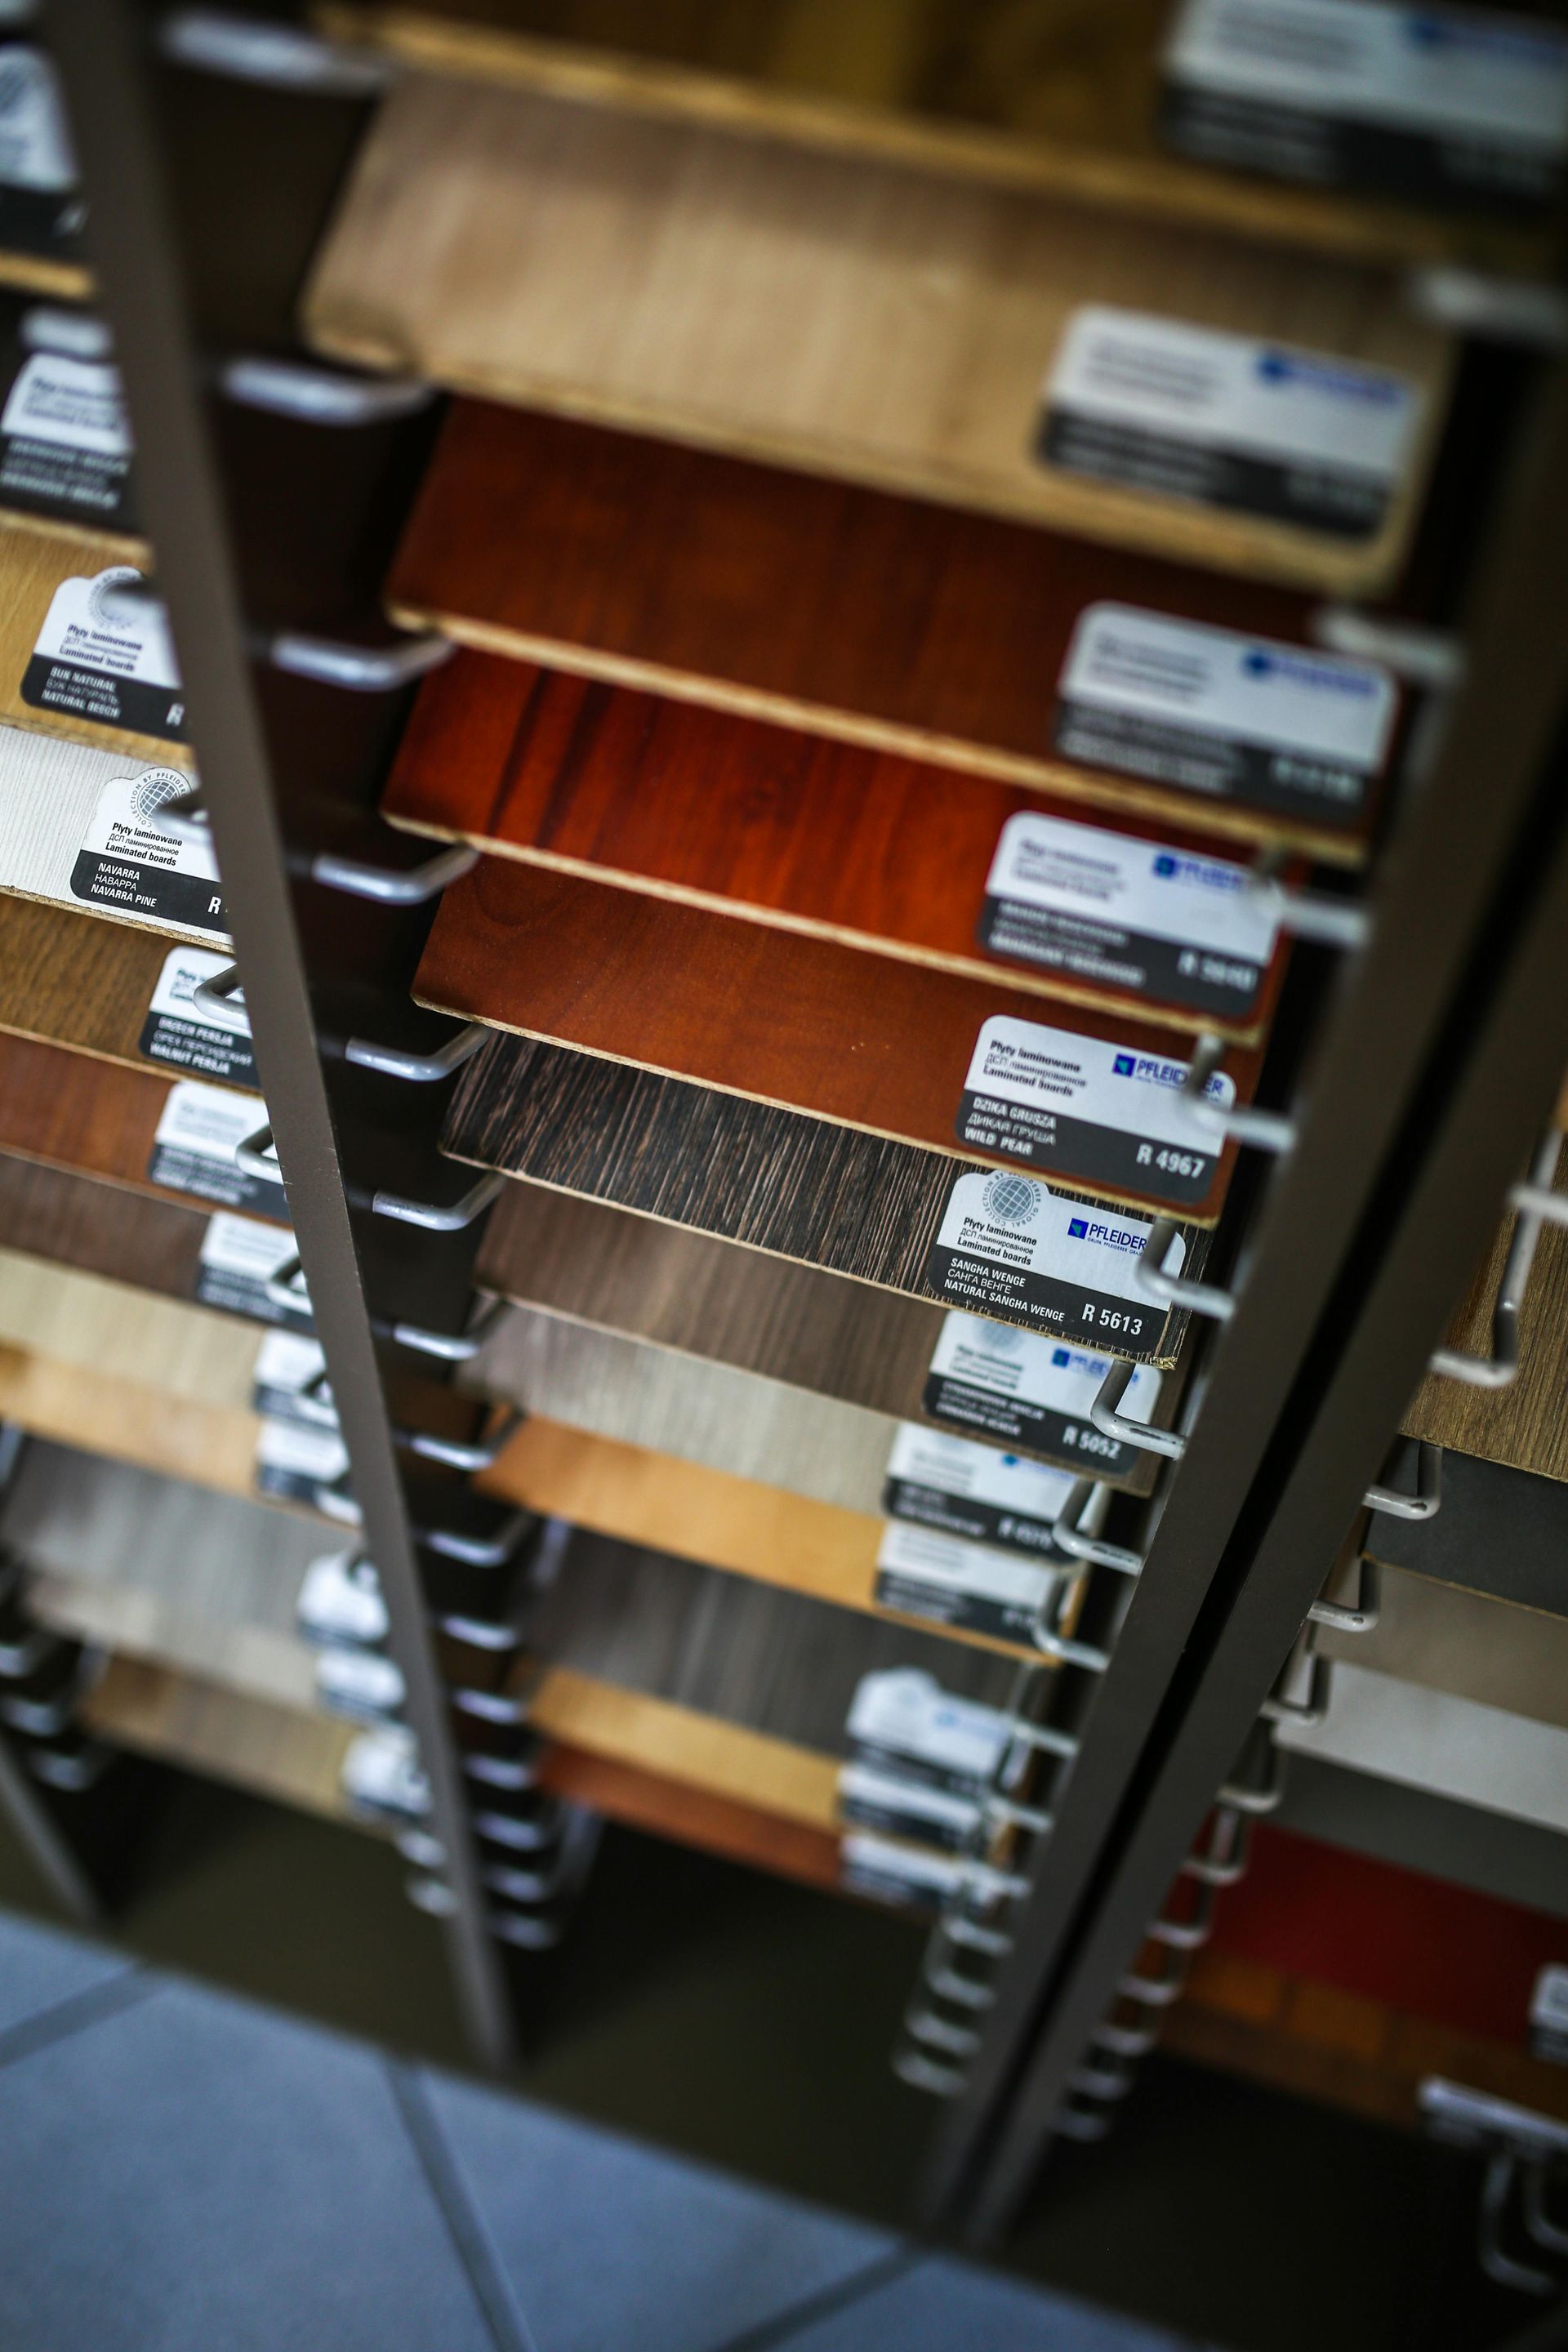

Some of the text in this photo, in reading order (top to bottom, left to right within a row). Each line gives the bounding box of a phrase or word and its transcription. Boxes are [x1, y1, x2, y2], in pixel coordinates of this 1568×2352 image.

[71, 672, 116, 693] NATURAL
[41, 689, 87, 710] NATURAL
[108, 833, 125, 843] ДСП
[133, 827, 183, 847] laminowane
[105, 841, 177, 866] Laminated boards
[98, 862, 140, 881] NAVARRA
[90, 884, 158, 907] NAVARRA PINE
[207, 896, 221, 915] R
[1136, 1059, 1223, 1095] PFLEIDER
[1009, 1106, 1057, 1130] GRUSZA
[964, 1125, 1033, 1156] WILD PEAR
[1136, 1143, 1205, 1178] R 4967
[960, 1227, 978, 1237] ДСП
[986, 1223, 1037, 1246] laminowane
[1089, 1223, 1147, 1251] PFLEIDER
[957, 1236, 1031, 1266] Laminated boards
[947, 1268, 1013, 1294] САНГА ВЕНГЕ
[951, 1258, 1027, 1288] SANGHA WENGE
[944, 1279, 1066, 1322] NATURAL SANGHA WENGE
[1081, 1303, 1143, 1335] R 5613
